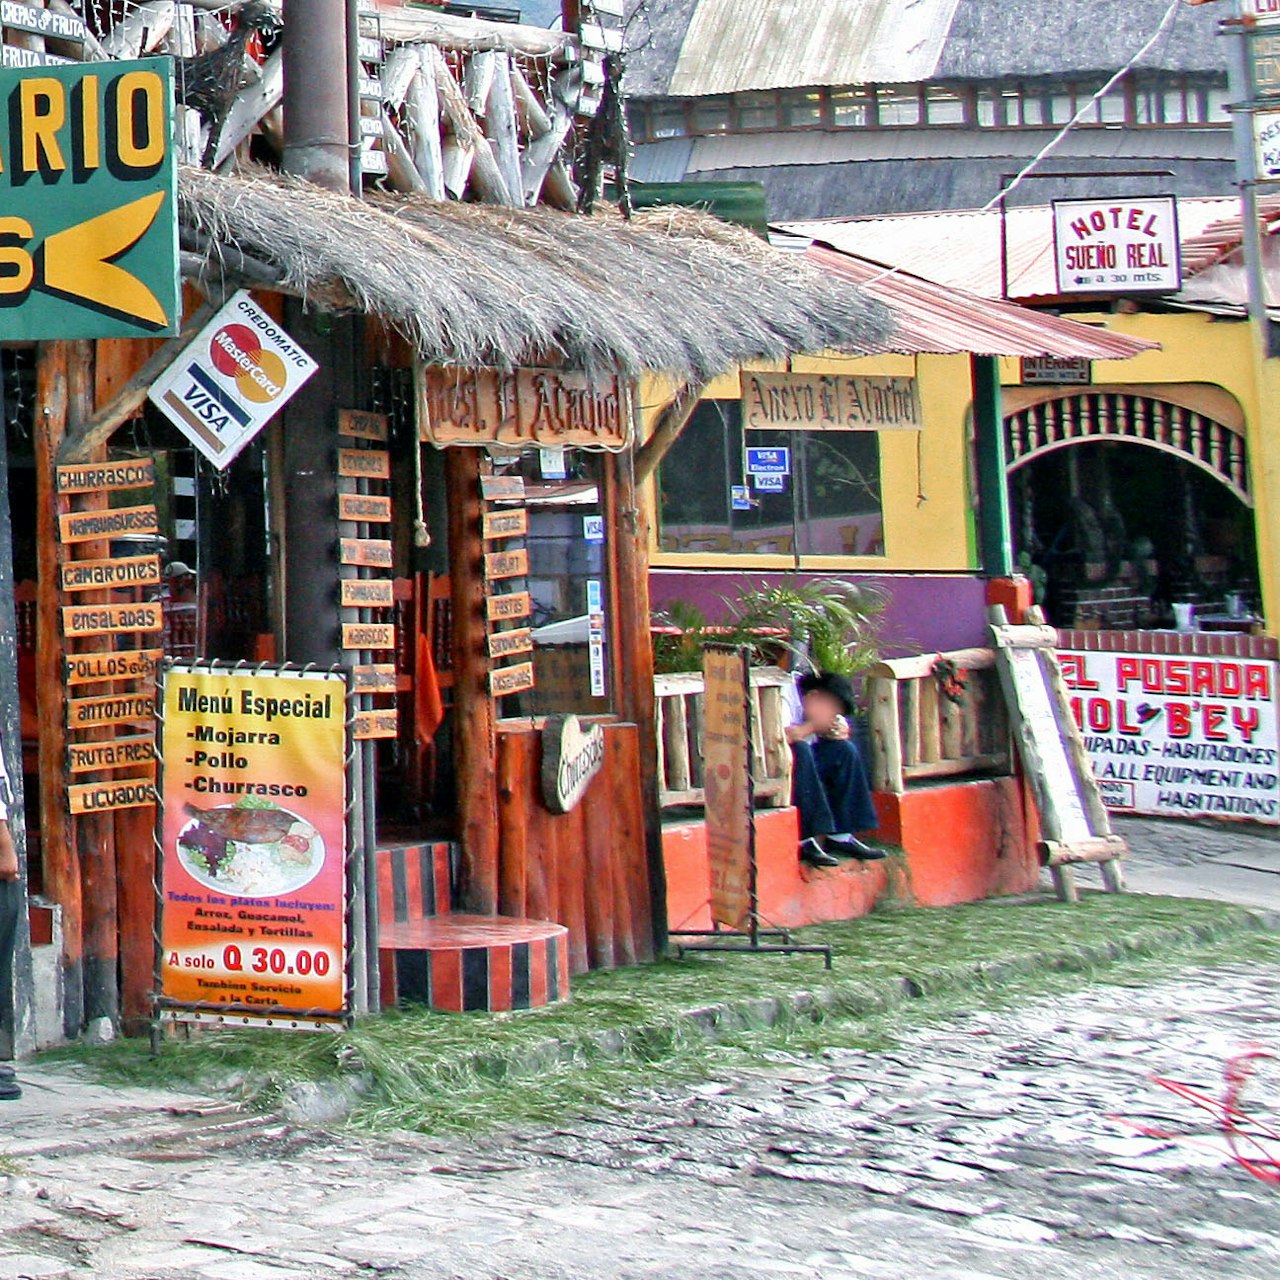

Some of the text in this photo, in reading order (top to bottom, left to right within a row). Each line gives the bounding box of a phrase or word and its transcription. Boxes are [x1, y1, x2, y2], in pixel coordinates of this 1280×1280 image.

[1, 0, 37, 28] CREPAS
[1070, 208, 1158, 240] HOTEL
[1066, 240, 1169, 270] SUEÑO REAL
[238, 301, 308, 368] CREDOMATIC
[215, 332, 282, 399] MasterCard
[184, 384, 230, 432] VISA
[758, 476, 782, 486] VISA
[67, 657, 126, 678] POLLOS
[1116, 657, 1270, 700] POSADA
[178, 687, 331, 721] Menú Especial
[186, 725, 281, 747] -Mojarra
[185, 751, 248, 769] -Pollo
[184, 776, 308, 798] -Churrasco
[1103, 761, 1277, 791] ALL EQUIPMENT AND
[1157, 790, 1277, 815] HABITATIONS
[168, 891, 202, 903] Todos
[207, 894, 225, 904] los
[231, 896, 271, 908] platos
[187, 921, 314, 938] Ensalada Tortillas
[168, 945, 330, 976] A solo Q 30.00
[245, 996, 279, 1006] Carta
[251, 982, 302, 994] Servicio
